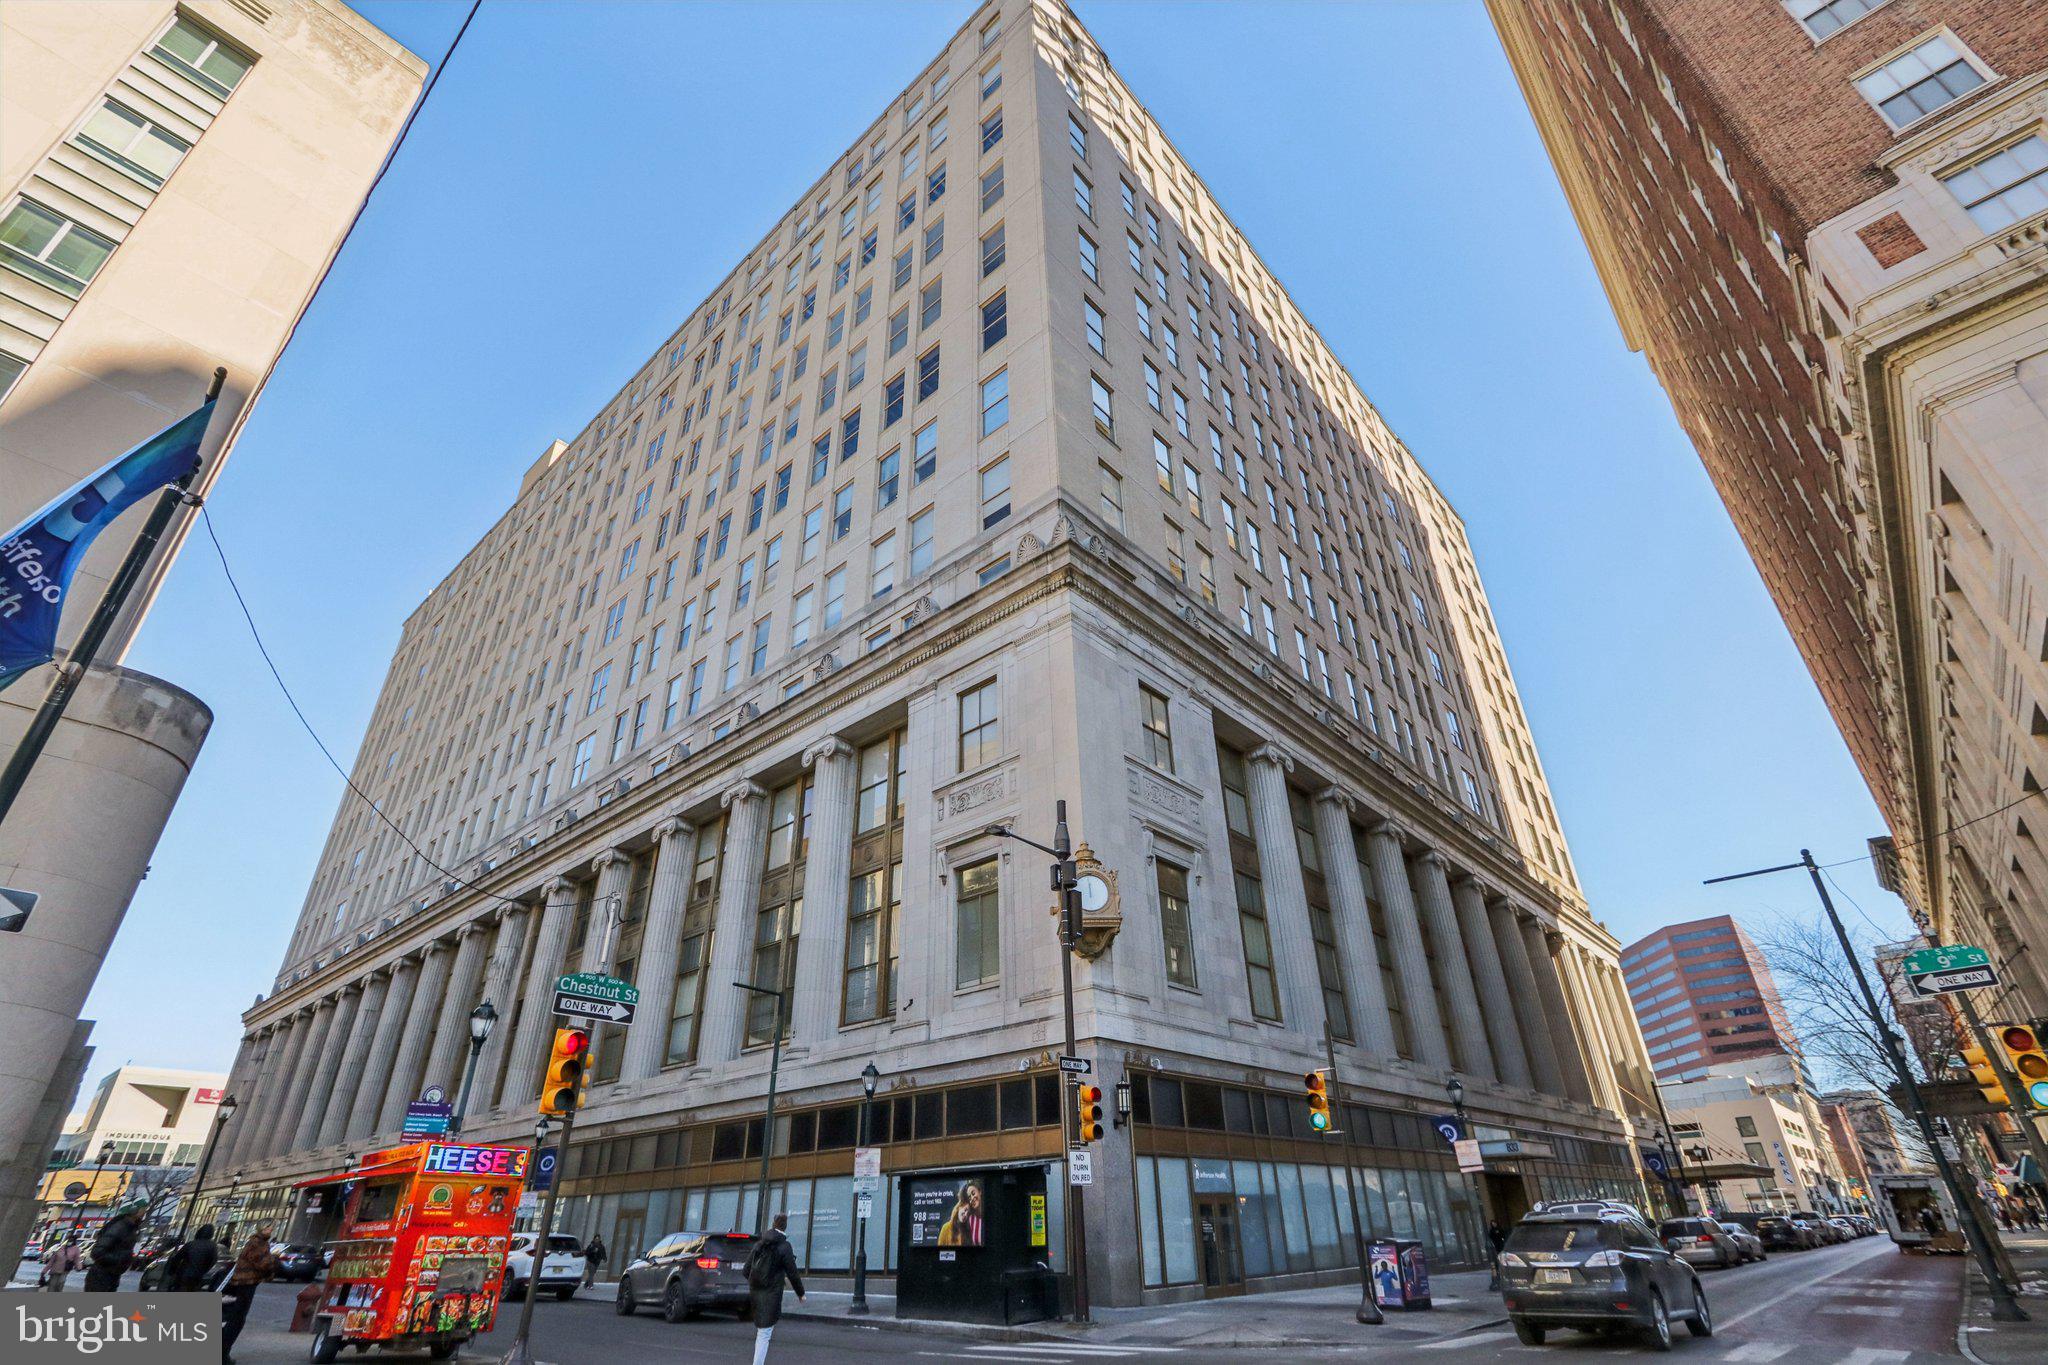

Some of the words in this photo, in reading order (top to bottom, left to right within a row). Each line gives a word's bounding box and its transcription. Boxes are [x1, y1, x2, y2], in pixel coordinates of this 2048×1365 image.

[1937, 954, 1957, 968] 9th
[1968, 954, 1984, 963] St
[1937, 975, 1960, 986] ONE
[1962, 972, 1985, 983] WAY
[560, 977, 620, 999] Chestnut
[624, 989, 637, 1002] St
[565, 1000, 587, 1011] ONE
[590, 1004, 613, 1015] WAY
[1073, 1061, 1082, 1069] WAY
[105, 1132, 171, 1140] INDUSTRIOUS
[425, 1148, 511, 1173] HEESE
[913, 1212, 927, 1222] 988
